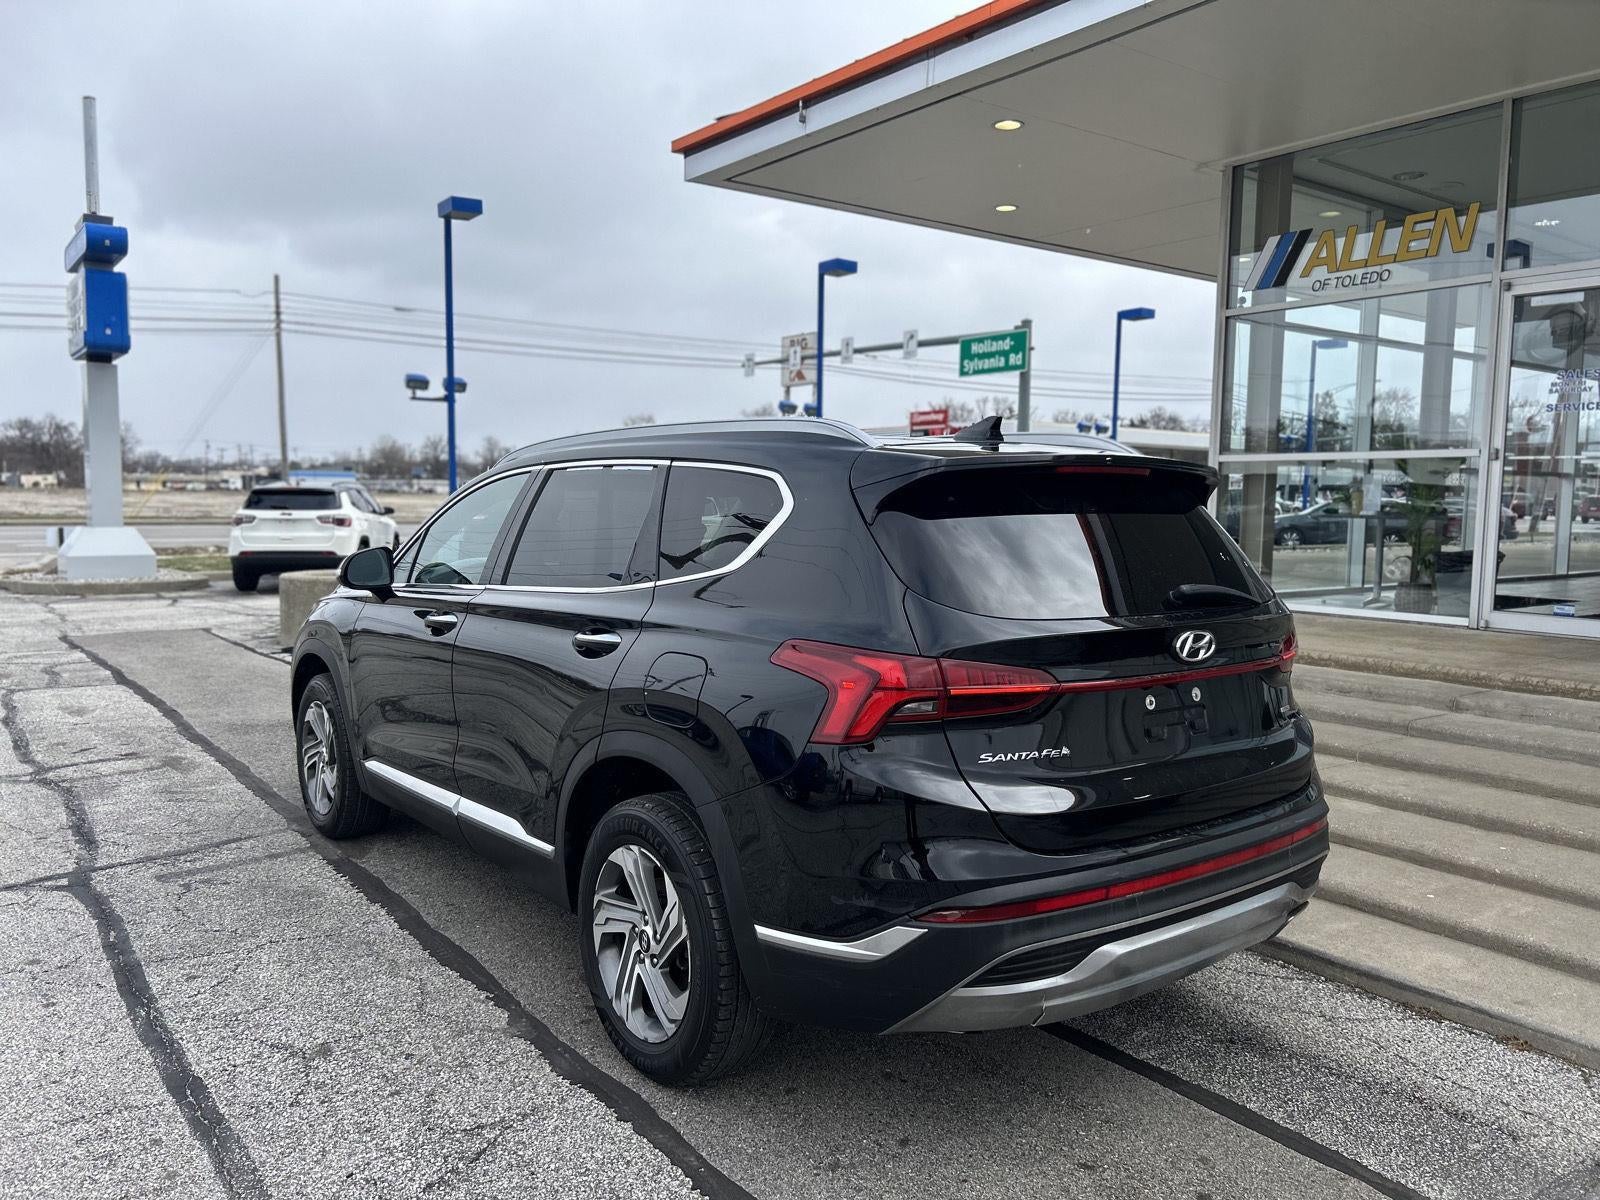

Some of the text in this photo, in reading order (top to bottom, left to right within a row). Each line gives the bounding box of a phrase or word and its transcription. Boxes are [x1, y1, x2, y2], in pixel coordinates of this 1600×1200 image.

[1300, 201, 1481, 279] ALLEN
[1311, 268, 1391, 292] OF TOLEDO
[971, 336, 1014, 355] Holland-
[963, 351, 1023, 374] Sylvania Rd
[1557, 369, 1600, 380] SALES
[1548, 386, 1593, 394] SATURDAY
